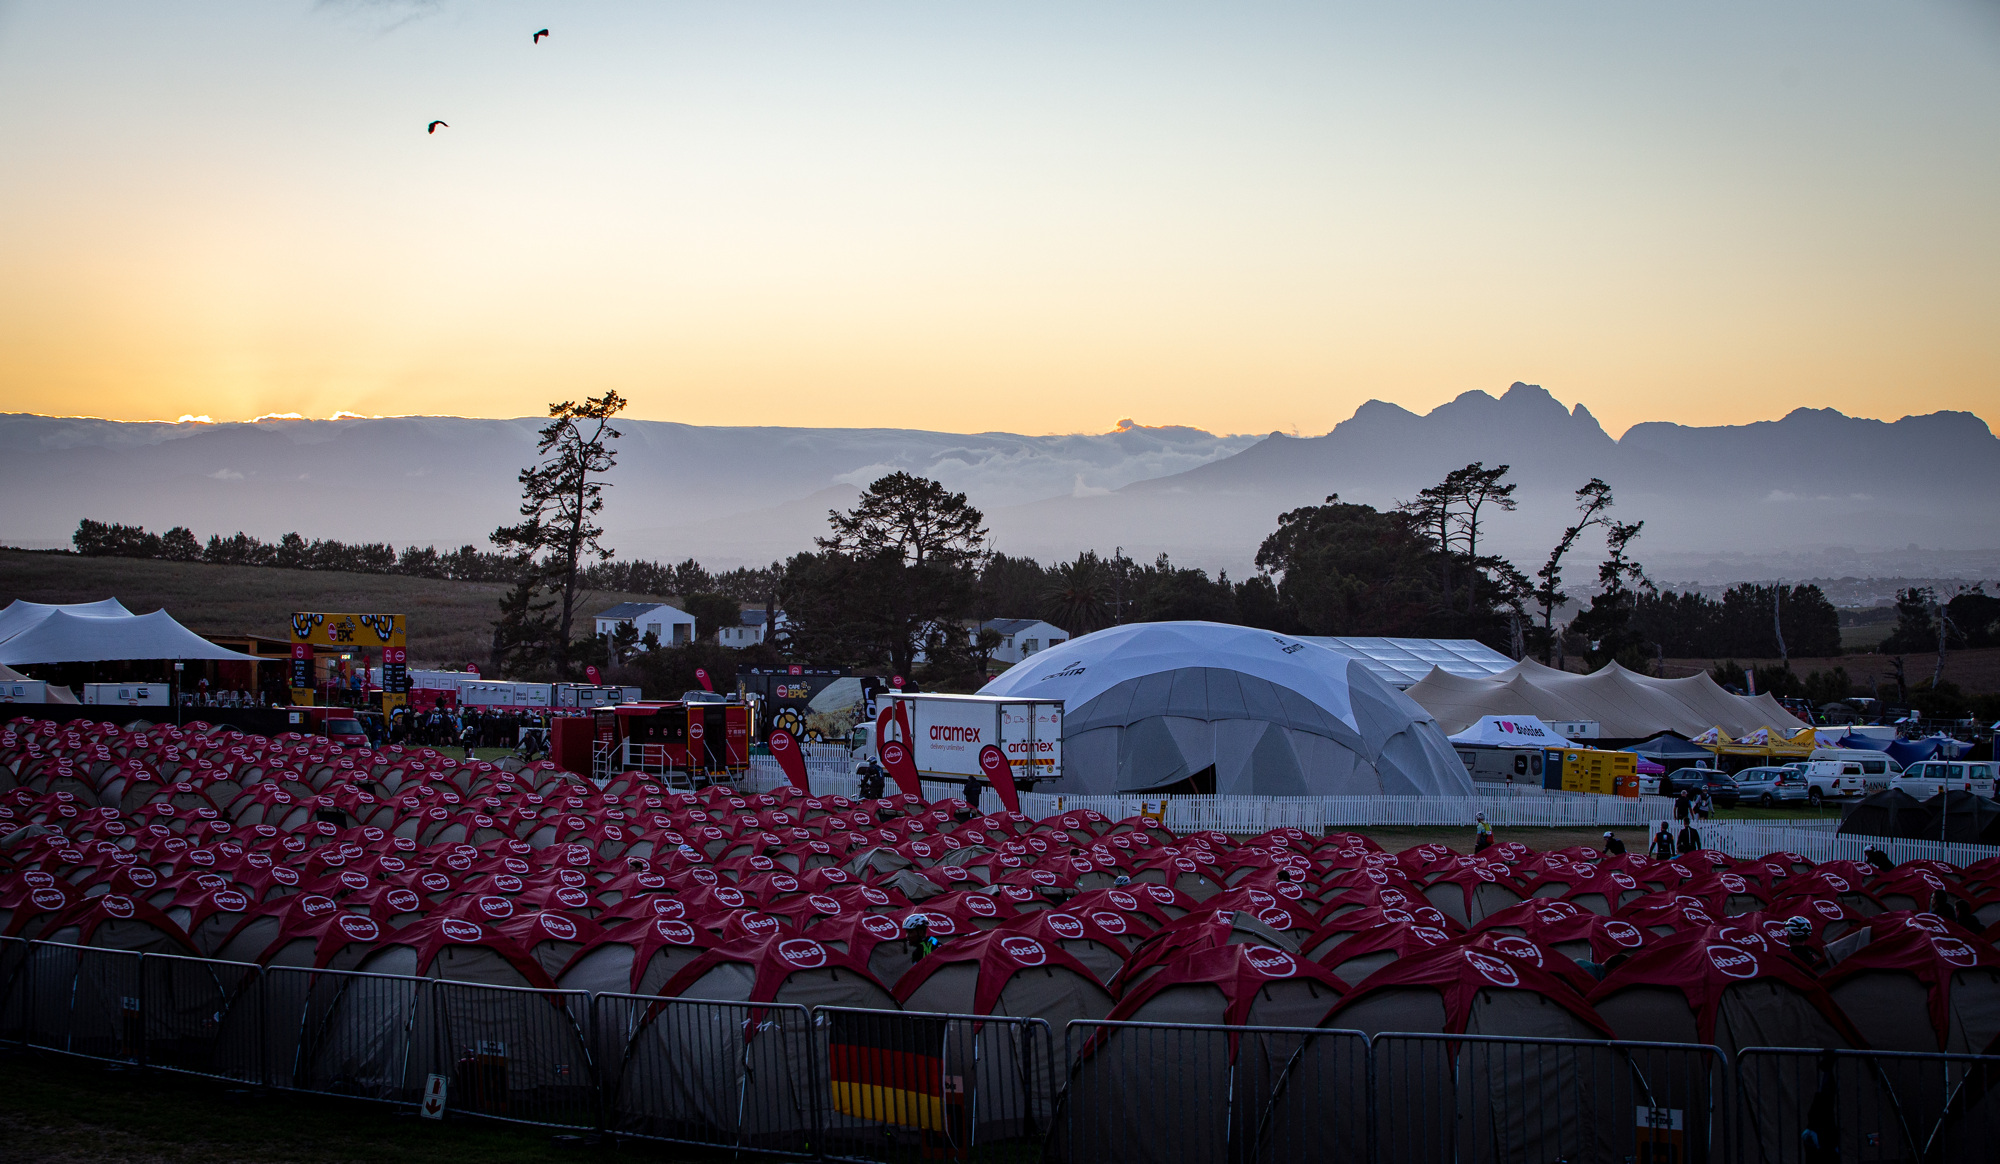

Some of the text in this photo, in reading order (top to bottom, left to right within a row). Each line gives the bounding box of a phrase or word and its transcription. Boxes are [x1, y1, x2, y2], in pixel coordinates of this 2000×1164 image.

[338, 630, 353, 642] EPIC
[788, 689, 808, 698] EPIC
[1493, 721, 1545, 737] I Boobies
[930, 725, 981, 743] aramex
[930, 743, 946, 752] delivery
[1008, 742, 1054, 753] aramex
[115, 852, 135, 860] absa
[326, 853, 345, 861] absa
[568, 855, 589, 863] absa
[450, 858, 470, 866] absa
[27, 875, 52, 883] absa
[274, 871, 296, 879] absa
[201, 880, 223, 888] absa
[426, 877, 449, 886] absa
[497, 878, 520, 886] absa
[775, 879, 795, 887] absa
[1280, 885, 1299, 893] absa
[34, 892, 61, 902] absa
[217, 895, 242, 904] absa
[391, 894, 417, 905] absa
[721, 891, 742, 900] absa
[866, 891, 886, 899] absa
[1112, 895, 1134, 904] absa
[1382, 893, 1403, 903] absa
[105, 899, 130, 910] absa
[306, 901, 333, 911] absa
[484, 902, 509, 911] absa
[658, 903, 682, 912] absa
[1818, 904, 1839, 913] absa
[743, 918, 774, 929] absa
[1096, 918, 1121, 926] absa
[1263, 913, 1289, 925] absa
[345, 923, 374, 931] absa
[446, 926, 477, 934] absa
[545, 920, 572, 931] absa
[863, 922, 893, 932] absa
[1053, 921, 1079, 930] absa
[659, 928, 690, 936] absa
[1610, 929, 1635, 940] absa
[1769, 927, 1788, 940] abs
[785, 947, 820, 959] absa
[1008, 944, 1041, 957] absa
[1937, 945, 1970, 957] absa
[1251, 956, 1287, 967] absa
[1715, 952, 1749, 967] absa
